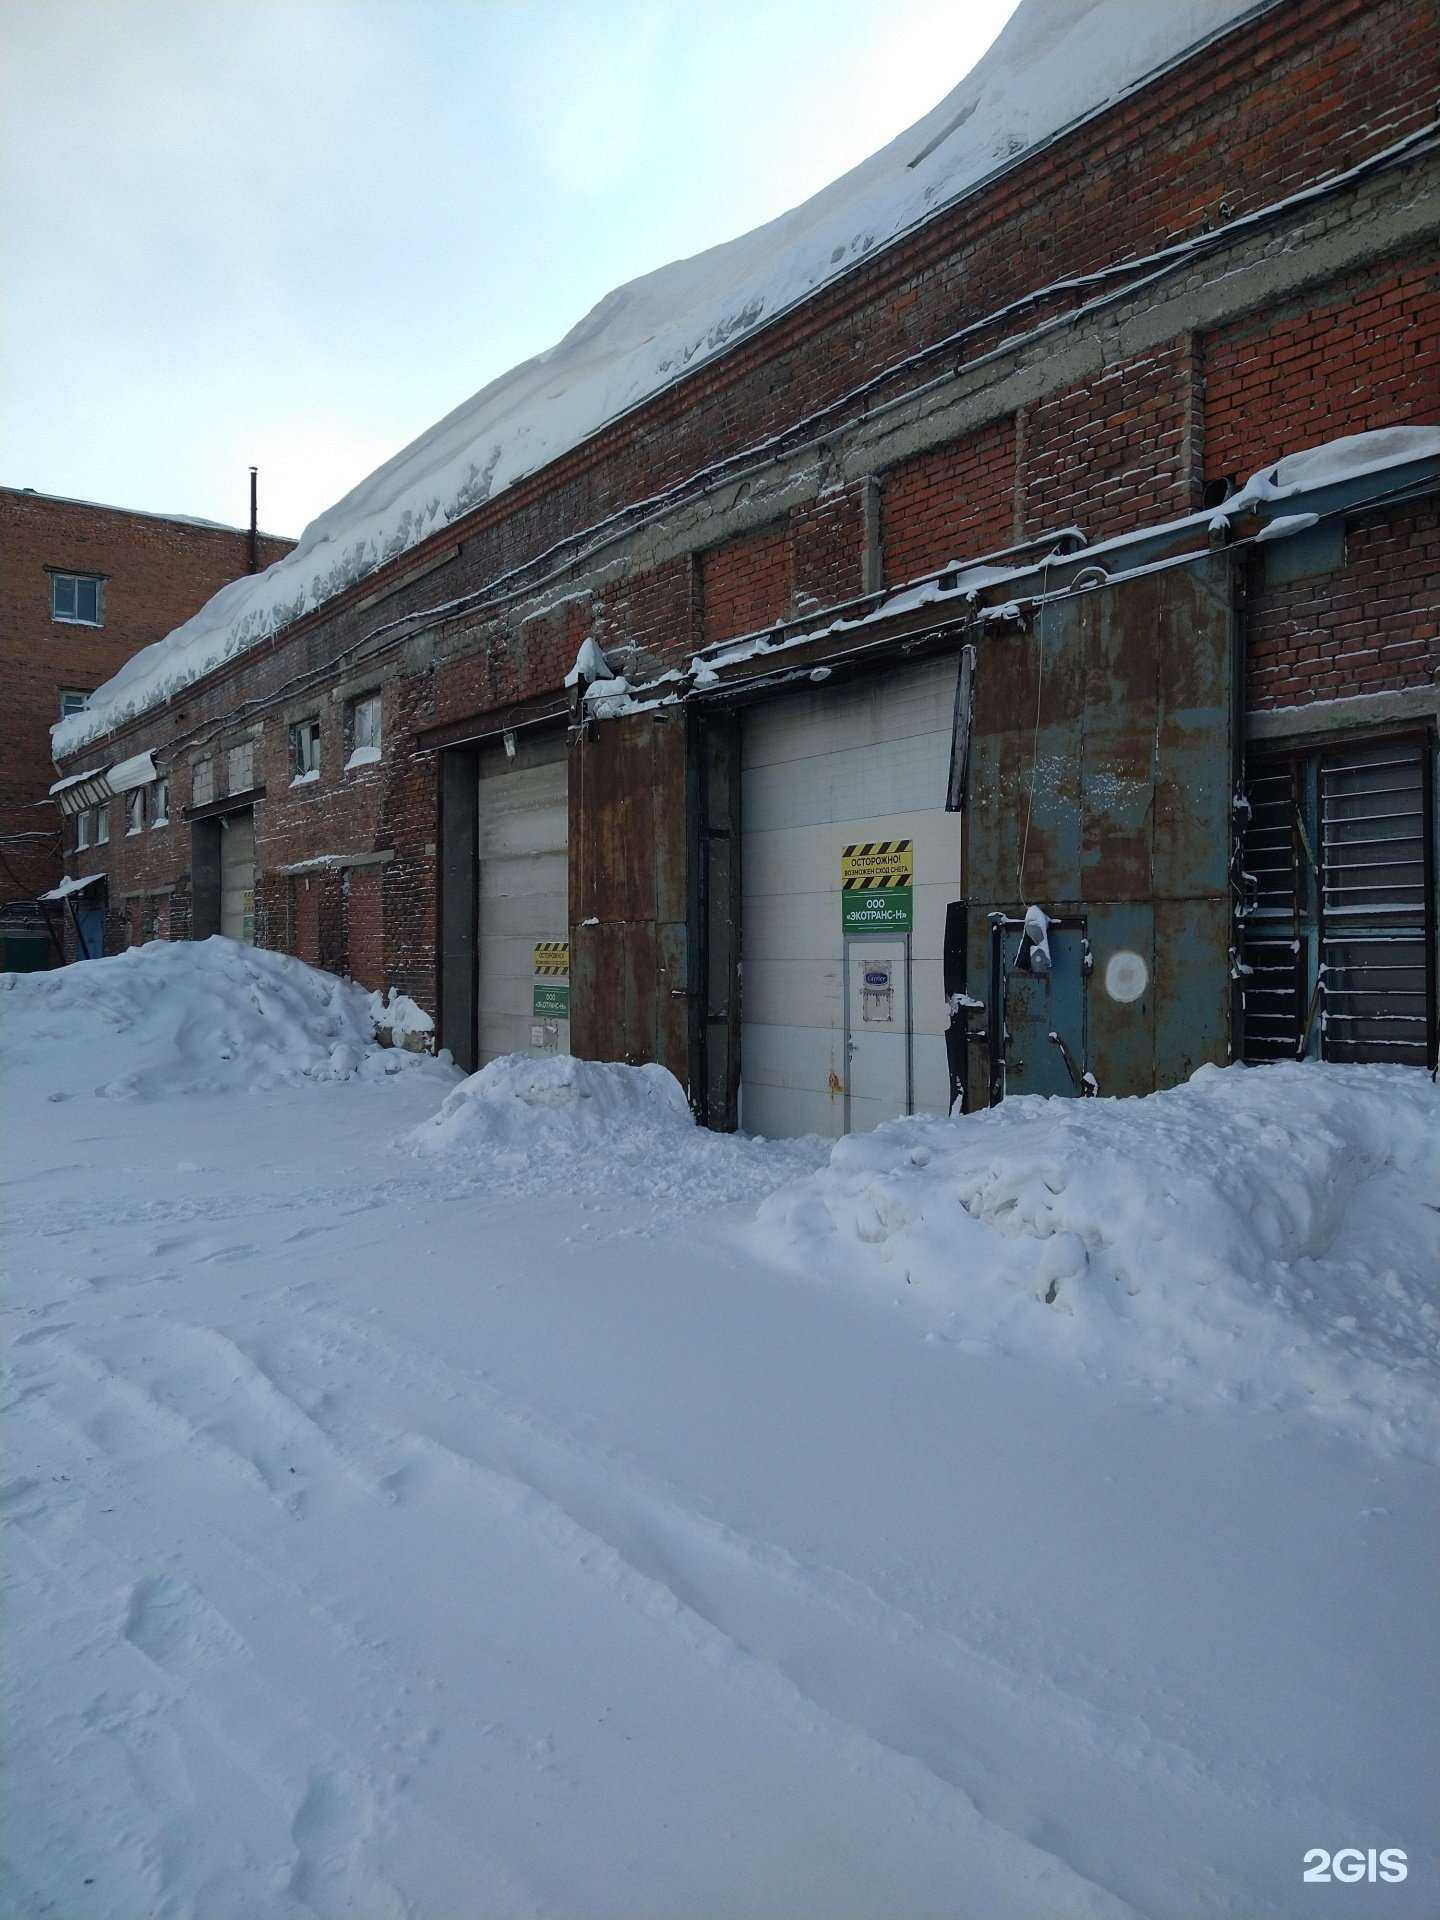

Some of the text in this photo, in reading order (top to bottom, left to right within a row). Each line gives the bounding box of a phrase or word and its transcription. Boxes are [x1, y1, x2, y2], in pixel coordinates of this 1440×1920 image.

[851, 855, 901, 867] ОСТОРОЖНО!
[866, 899, 885, 909] ООО
[846, 909, 907, 921] «ЭКОТРАНС-Н»
